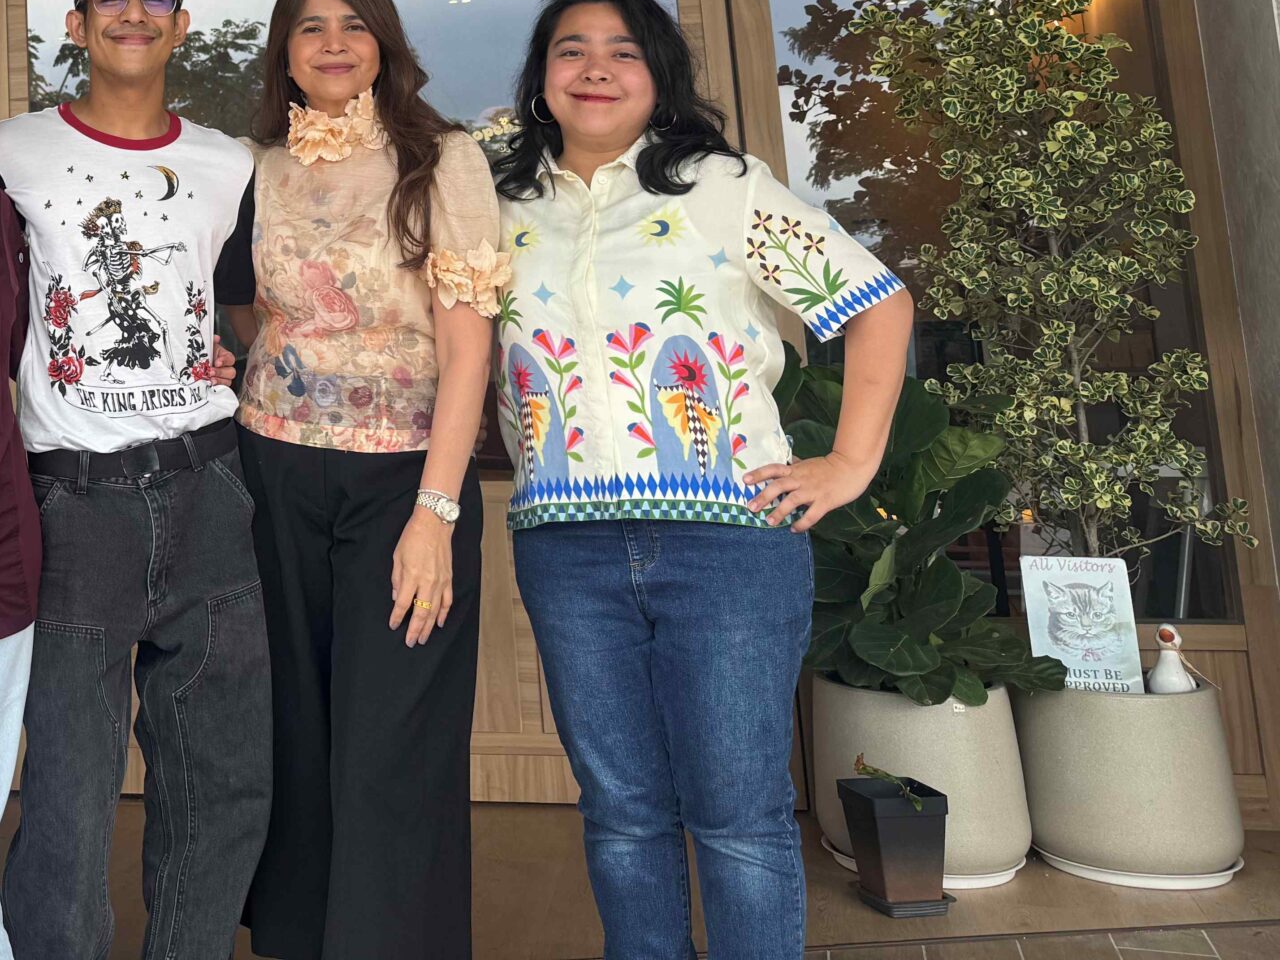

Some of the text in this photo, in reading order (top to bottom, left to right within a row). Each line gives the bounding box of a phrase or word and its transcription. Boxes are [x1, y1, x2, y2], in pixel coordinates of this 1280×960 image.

[101, 391, 136, 412] KING
[140, 387, 187, 412] ARISES
[1029, 558, 1116, 574] All Visitors
[1104, 668, 1123, 680] BE
[1064, 680, 1130, 693] PPROVED
